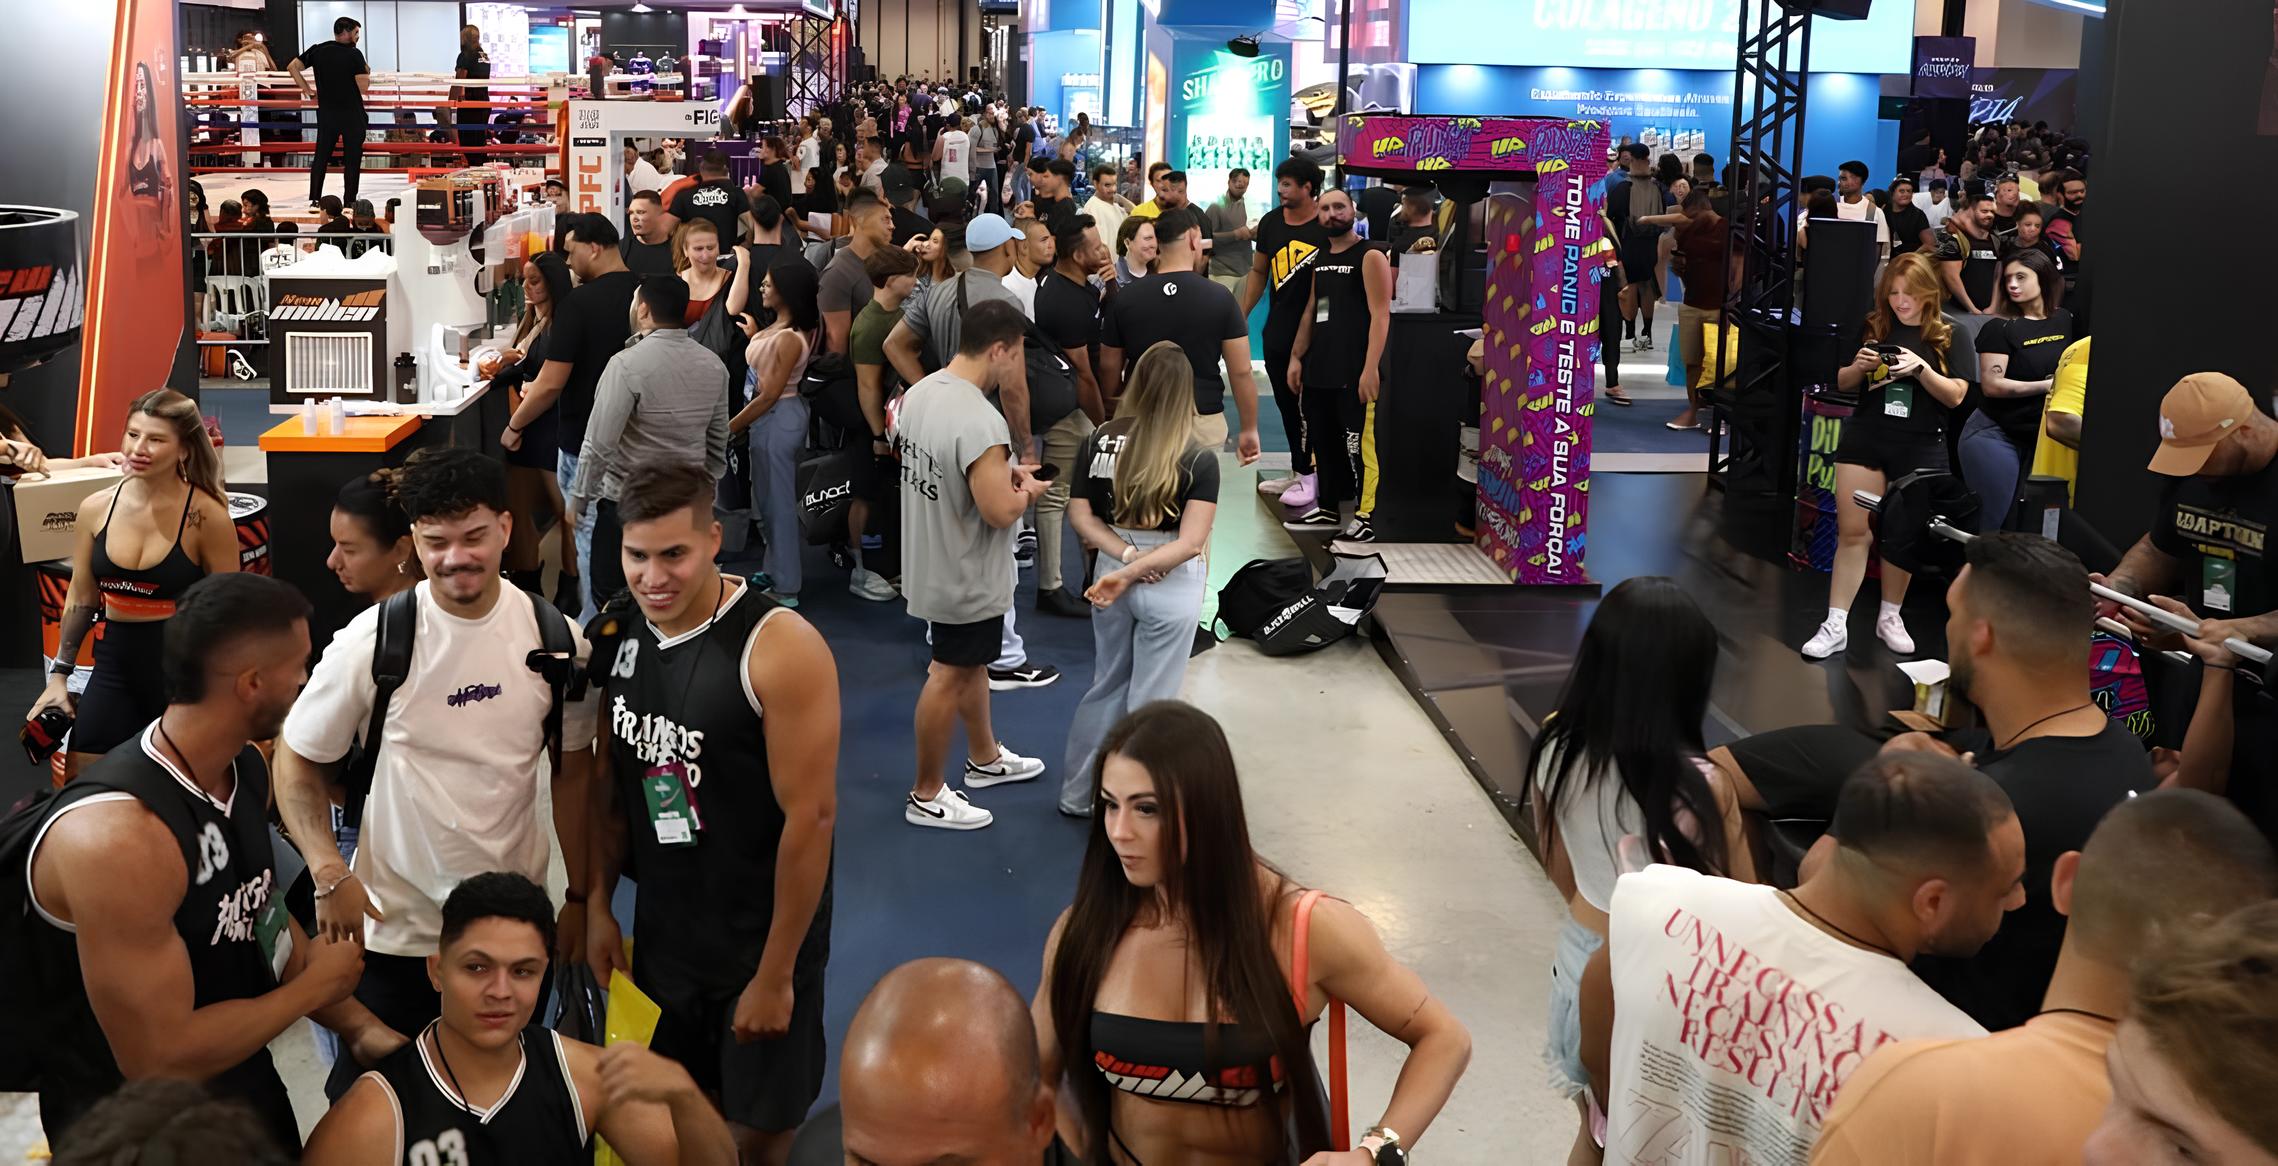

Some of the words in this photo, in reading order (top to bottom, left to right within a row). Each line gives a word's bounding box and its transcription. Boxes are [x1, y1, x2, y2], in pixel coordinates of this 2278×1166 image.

[1564, 174, 1583, 241] TOME
[1561, 244, 1579, 315] PANIC
[1559, 319, 1576, 335] E
[1556, 340, 1575, 414] TESTE
[1553, 417, 1571, 434] A
[1551, 440, 1569, 487] SUA
